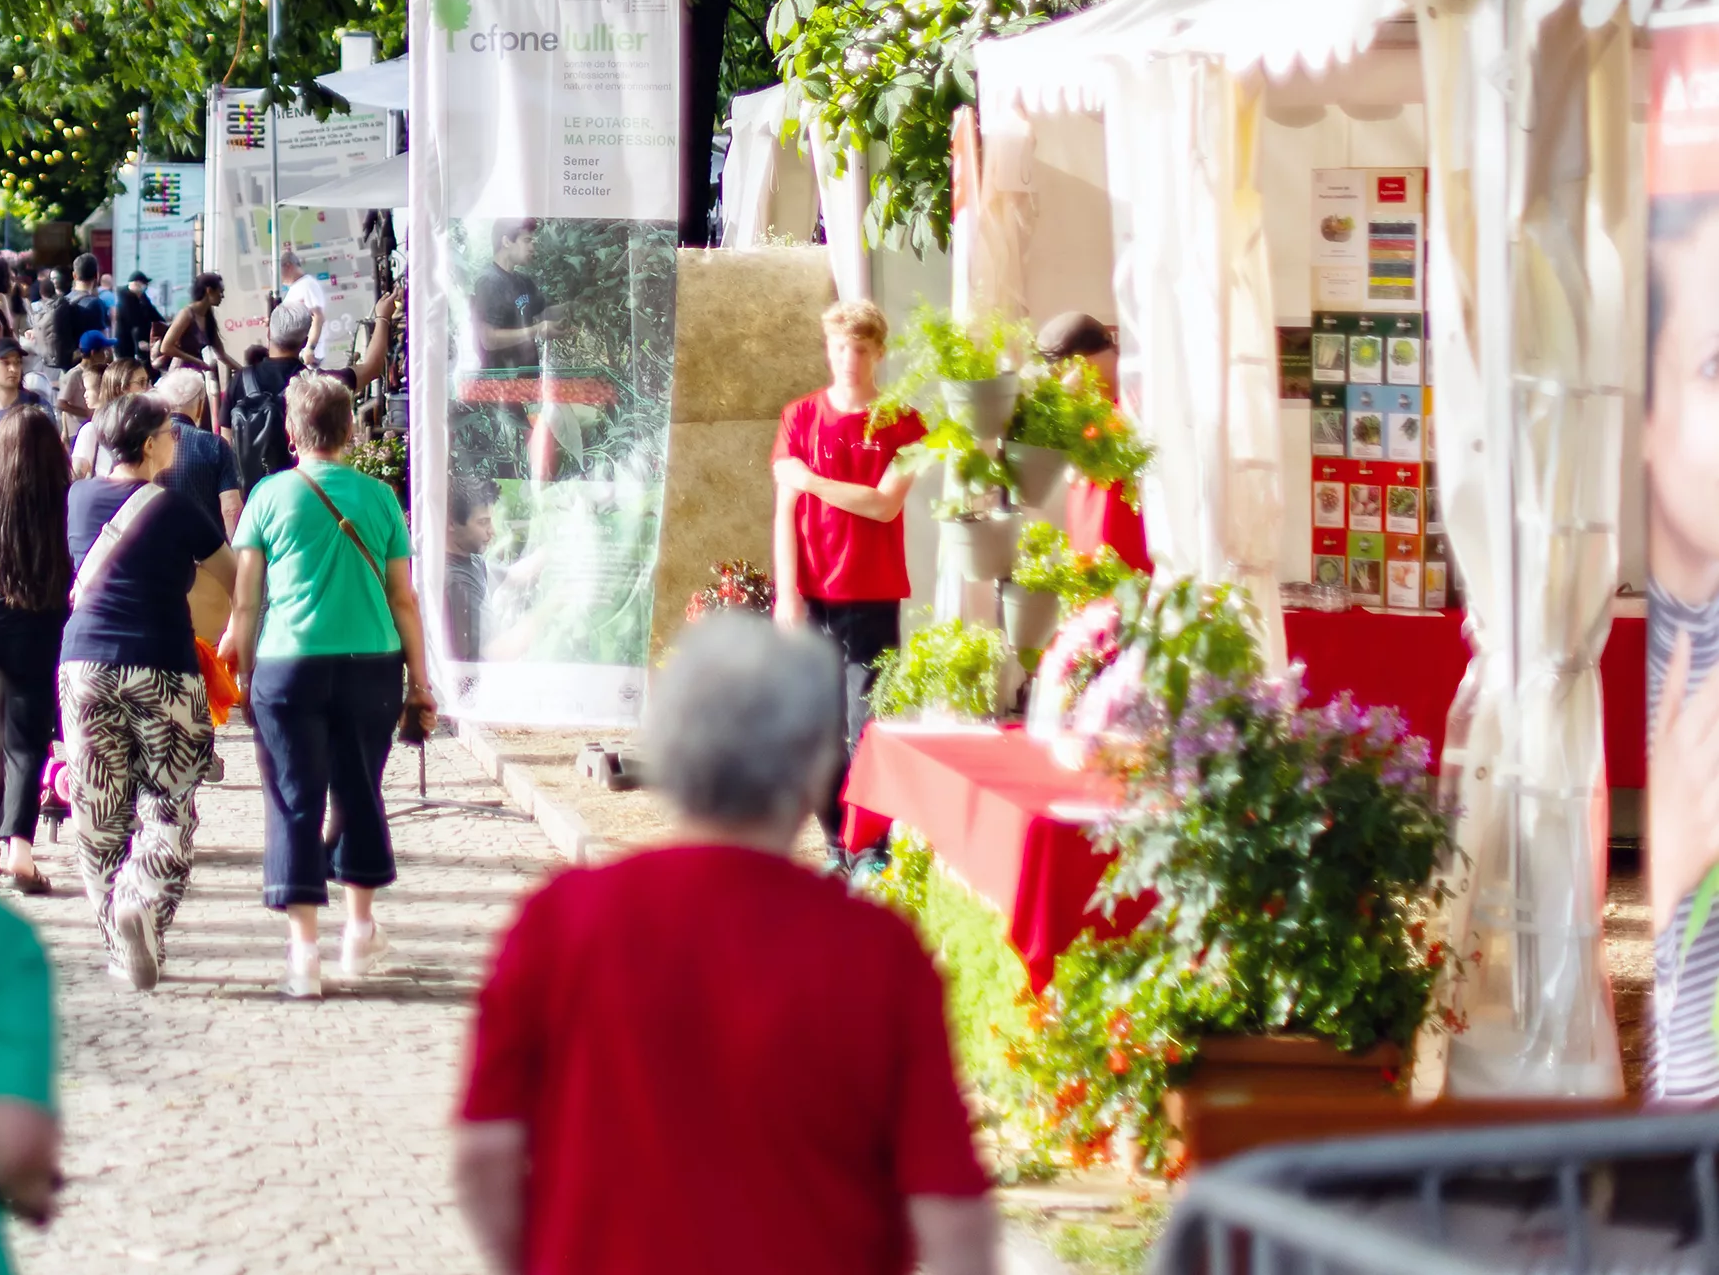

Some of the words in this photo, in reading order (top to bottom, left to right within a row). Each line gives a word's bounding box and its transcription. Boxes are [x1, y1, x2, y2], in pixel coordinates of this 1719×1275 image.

[470, 23, 558, 59] cfpne
[565, 23, 648, 51] lullier
[594, 60, 605, 69] de
[595, 82, 603, 91] et
[564, 117, 580, 128] LE
[586, 117, 654, 130] POTAGER,
[564, 134, 584, 145] MA
[589, 134, 675, 146] PROFESSION
[563, 156, 599, 166] Semer
[563, 170, 604, 181] Sarcler
[563, 185, 611, 196] Récolter
